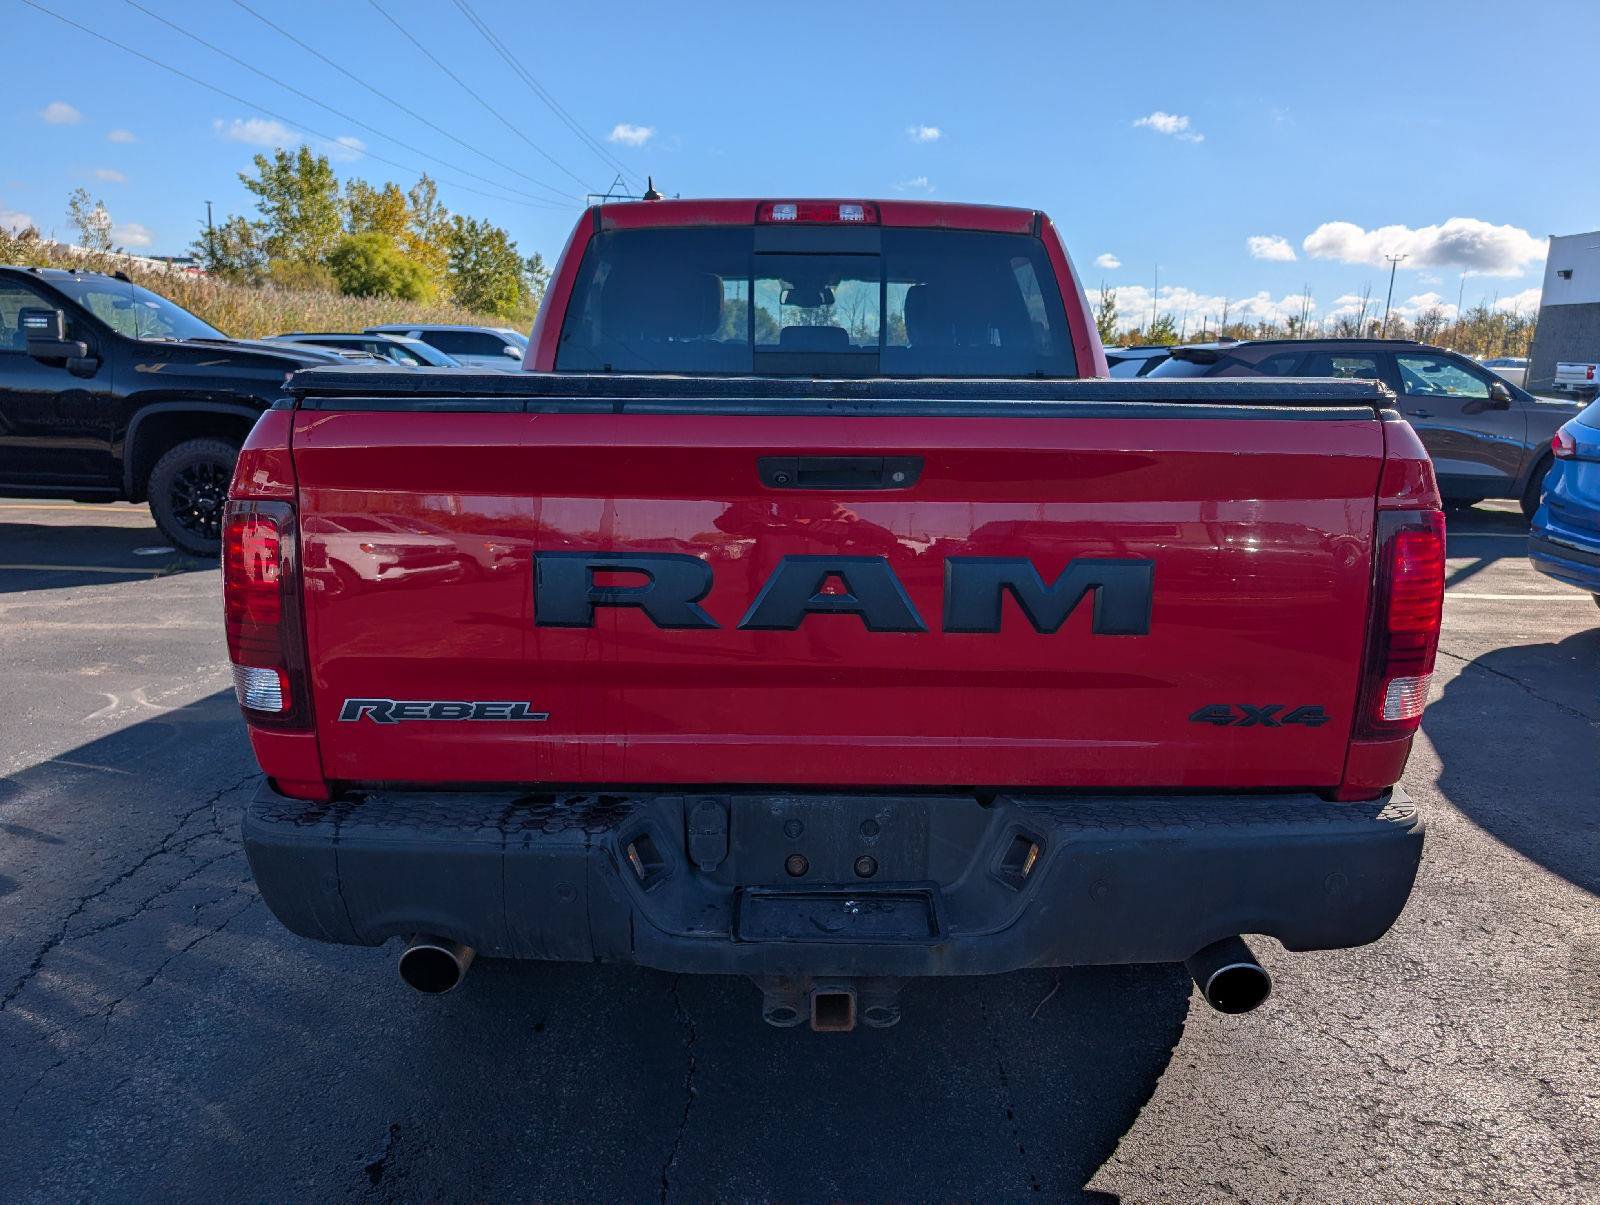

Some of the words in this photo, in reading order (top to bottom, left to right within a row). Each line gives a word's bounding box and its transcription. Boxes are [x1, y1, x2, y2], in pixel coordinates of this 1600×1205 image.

[533, 551, 1156, 635] RAM
[338, 698, 549, 724] REBEL
[1189, 704, 1332, 727] 4X4
